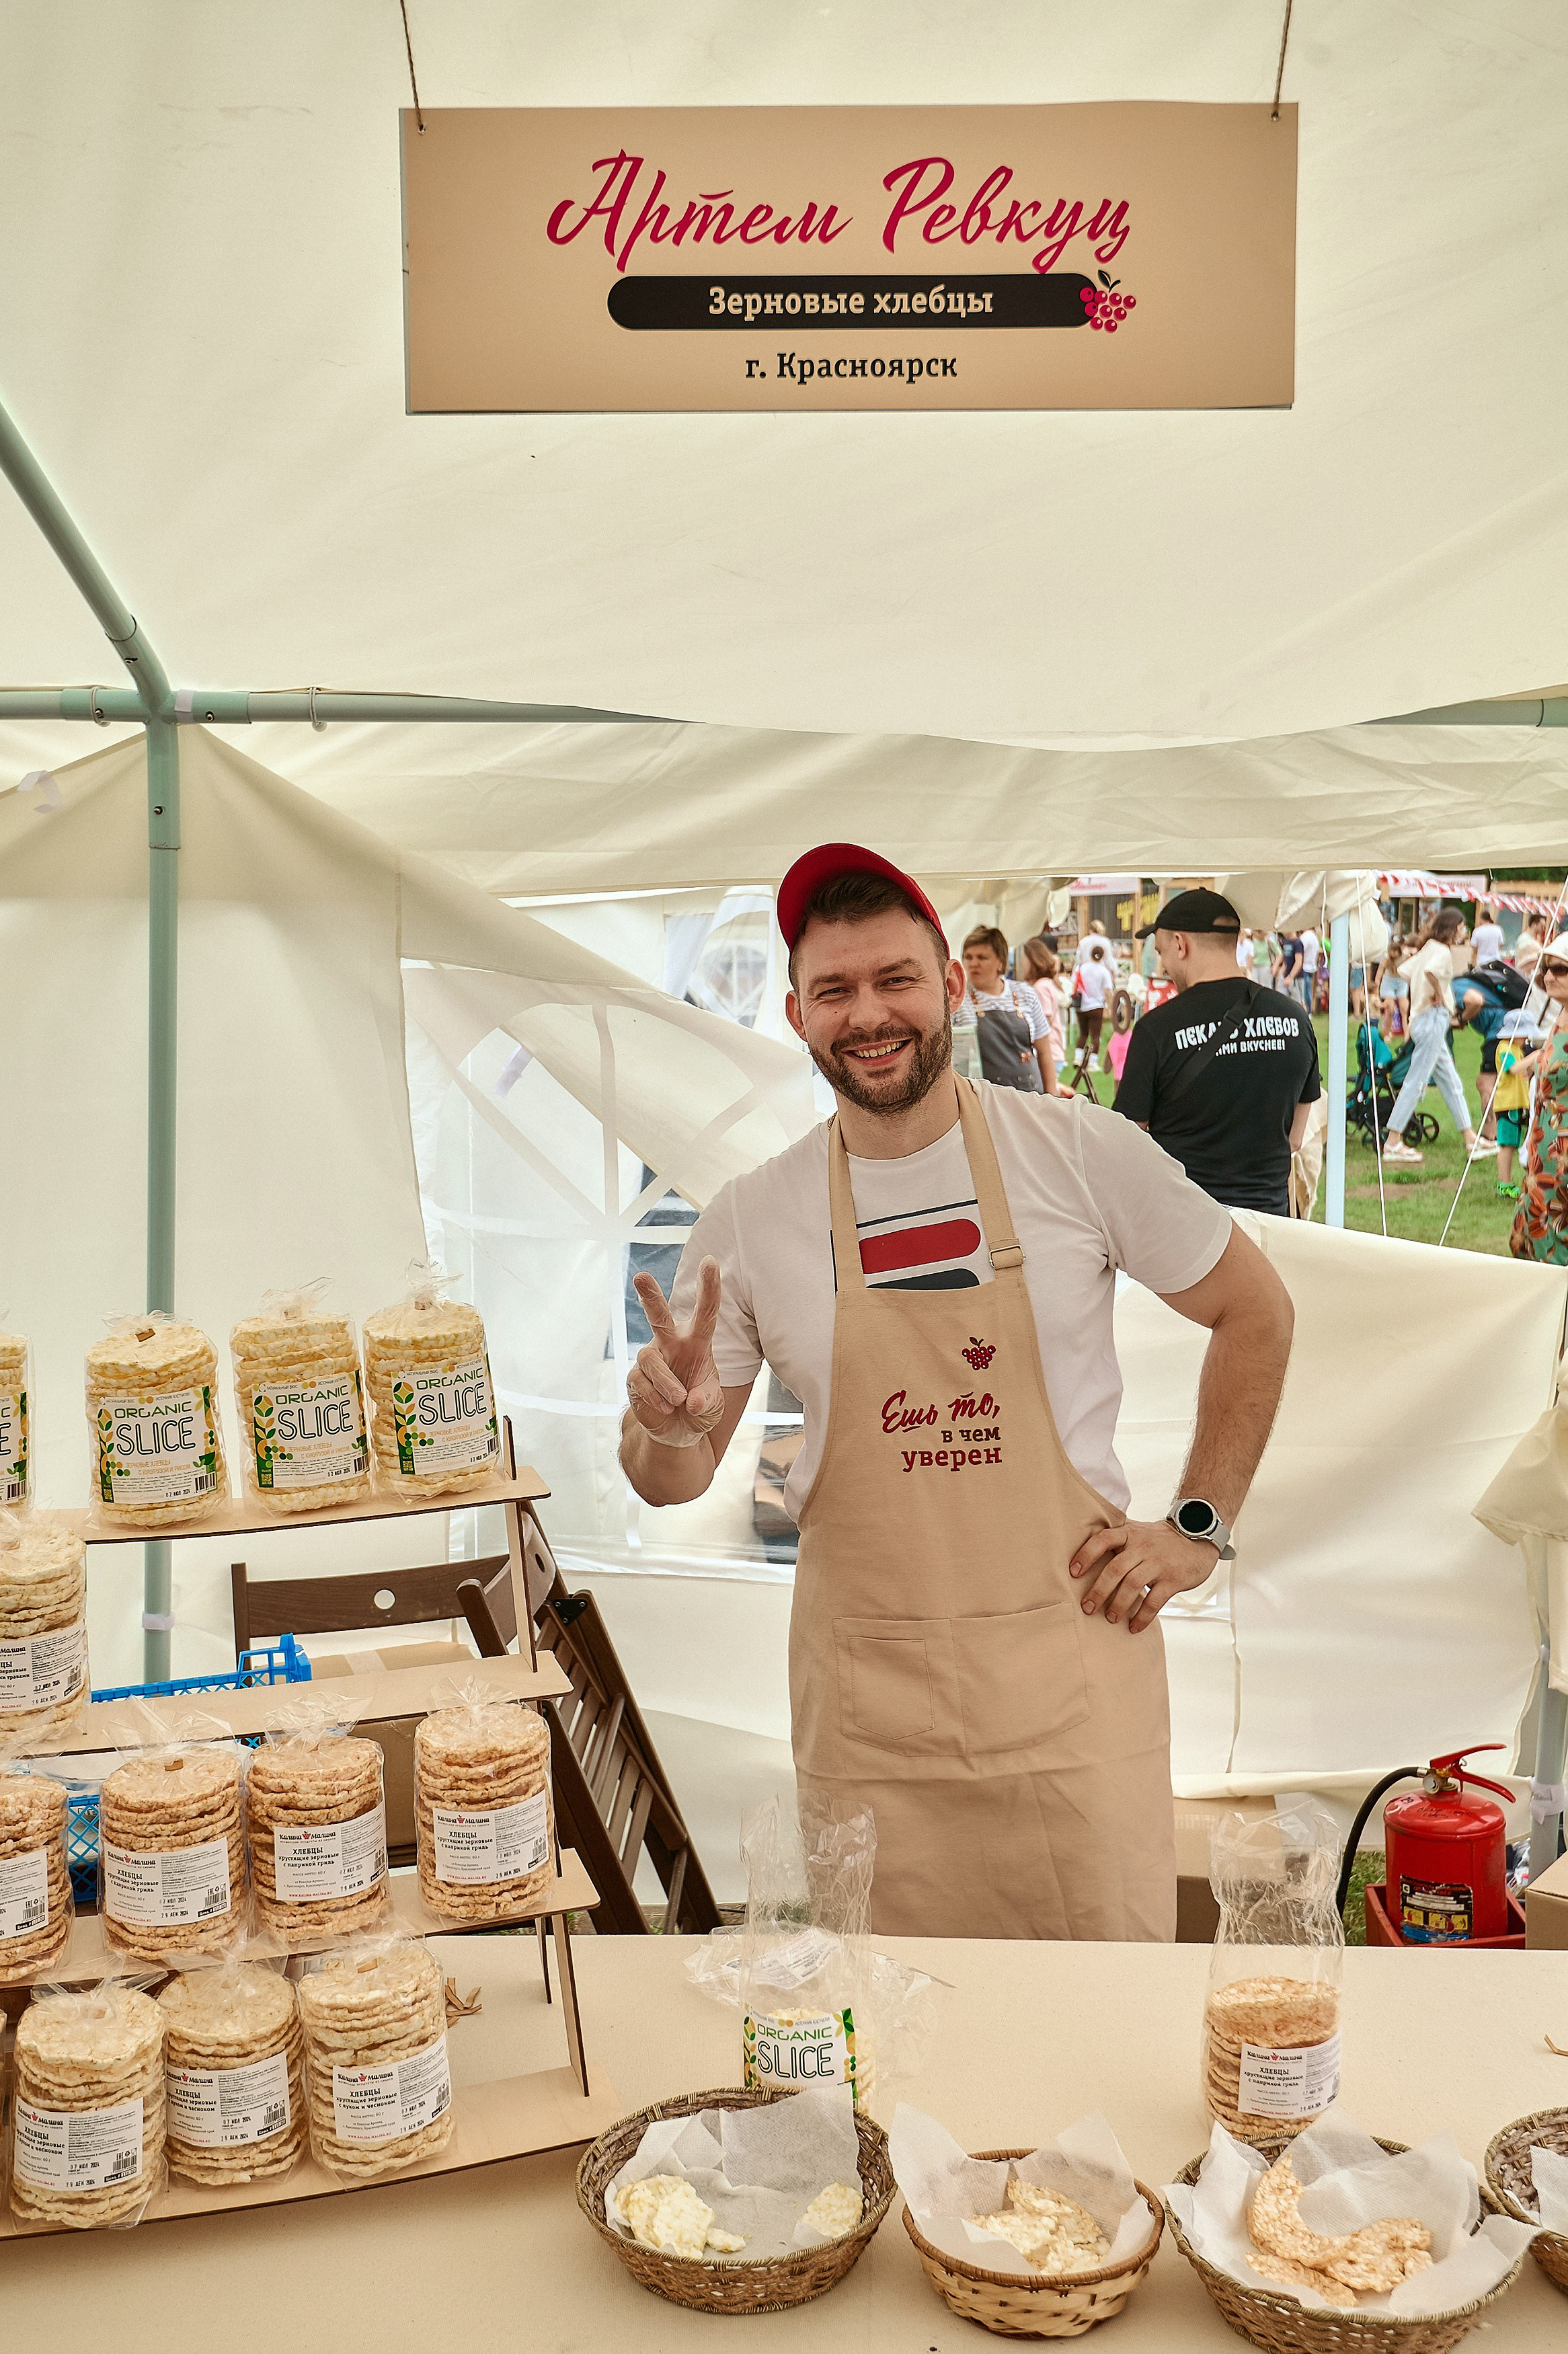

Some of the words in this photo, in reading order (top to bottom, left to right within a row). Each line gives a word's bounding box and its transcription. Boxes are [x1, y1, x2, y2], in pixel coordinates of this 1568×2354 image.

[547, 149, 853, 273] Артем
[882, 157, 1130, 274] Ревкуц
[709, 286, 865, 321] Зерновые
[873, 284, 993, 317] хлебцы
[745, 359, 767, 379] г.
[777, 352, 957, 385] Красноярск
[1243, 1016, 1299, 1038] ХЛЕБОВ
[1240, 1039, 1285, 1053] ВКУСНЕЕ!
[416, 1367, 483, 1390] ORGANIC
[276, 1384, 348, 1404] ORGANIC
[114, 1401, 192, 1418] ORGANIC
[418, 1381, 487, 1425] SLICE
[881, 1390, 939, 1433] Ешь
[947, 1392, 1001, 1422] то,
[278, 1399, 354, 1440] SLICE
[116, 1416, 196, 1455] SLICE
[941, 1430, 953, 1443] в
[959, 1427, 1001, 1442] чем
[901, 1447, 1003, 1473] уверен
[437, 1815, 457, 1823] Калина
[311, 1831, 336, 1839] Малина
[448, 1831, 477, 1839] ХЛЕБЦЫ
[311, 1852, 340, 1860] зерновые
[117, 1869, 143, 1880] ХЛЕБЦЫ
[757, 2023, 832, 2041] ORGANIC
[757, 2041, 834, 2079] SLICE
[1247, 2051, 1270, 2060] Калина
[338, 2073, 358, 2082] Калина
[367, 2072, 393, 2081] Малина
[1244, 2071, 1275, 2080] хрустящие
[1259, 2067, 1289, 2076] ХЛЕБЦЫ
[175, 2088, 200, 2099] ХЛЕБЦЫ
[350, 2088, 381, 2097] ХЛЕБЦЫ
[368, 2092, 397, 2102] зерновые
[366, 2099, 395, 2109] чесноком
[38, 2117, 64, 2125] Малина
[24, 2125, 49, 2140] ХЛЕБЦЫ
[35, 2146, 63, 2155] чесноком
[36, 2139, 65, 2148] зерновые
